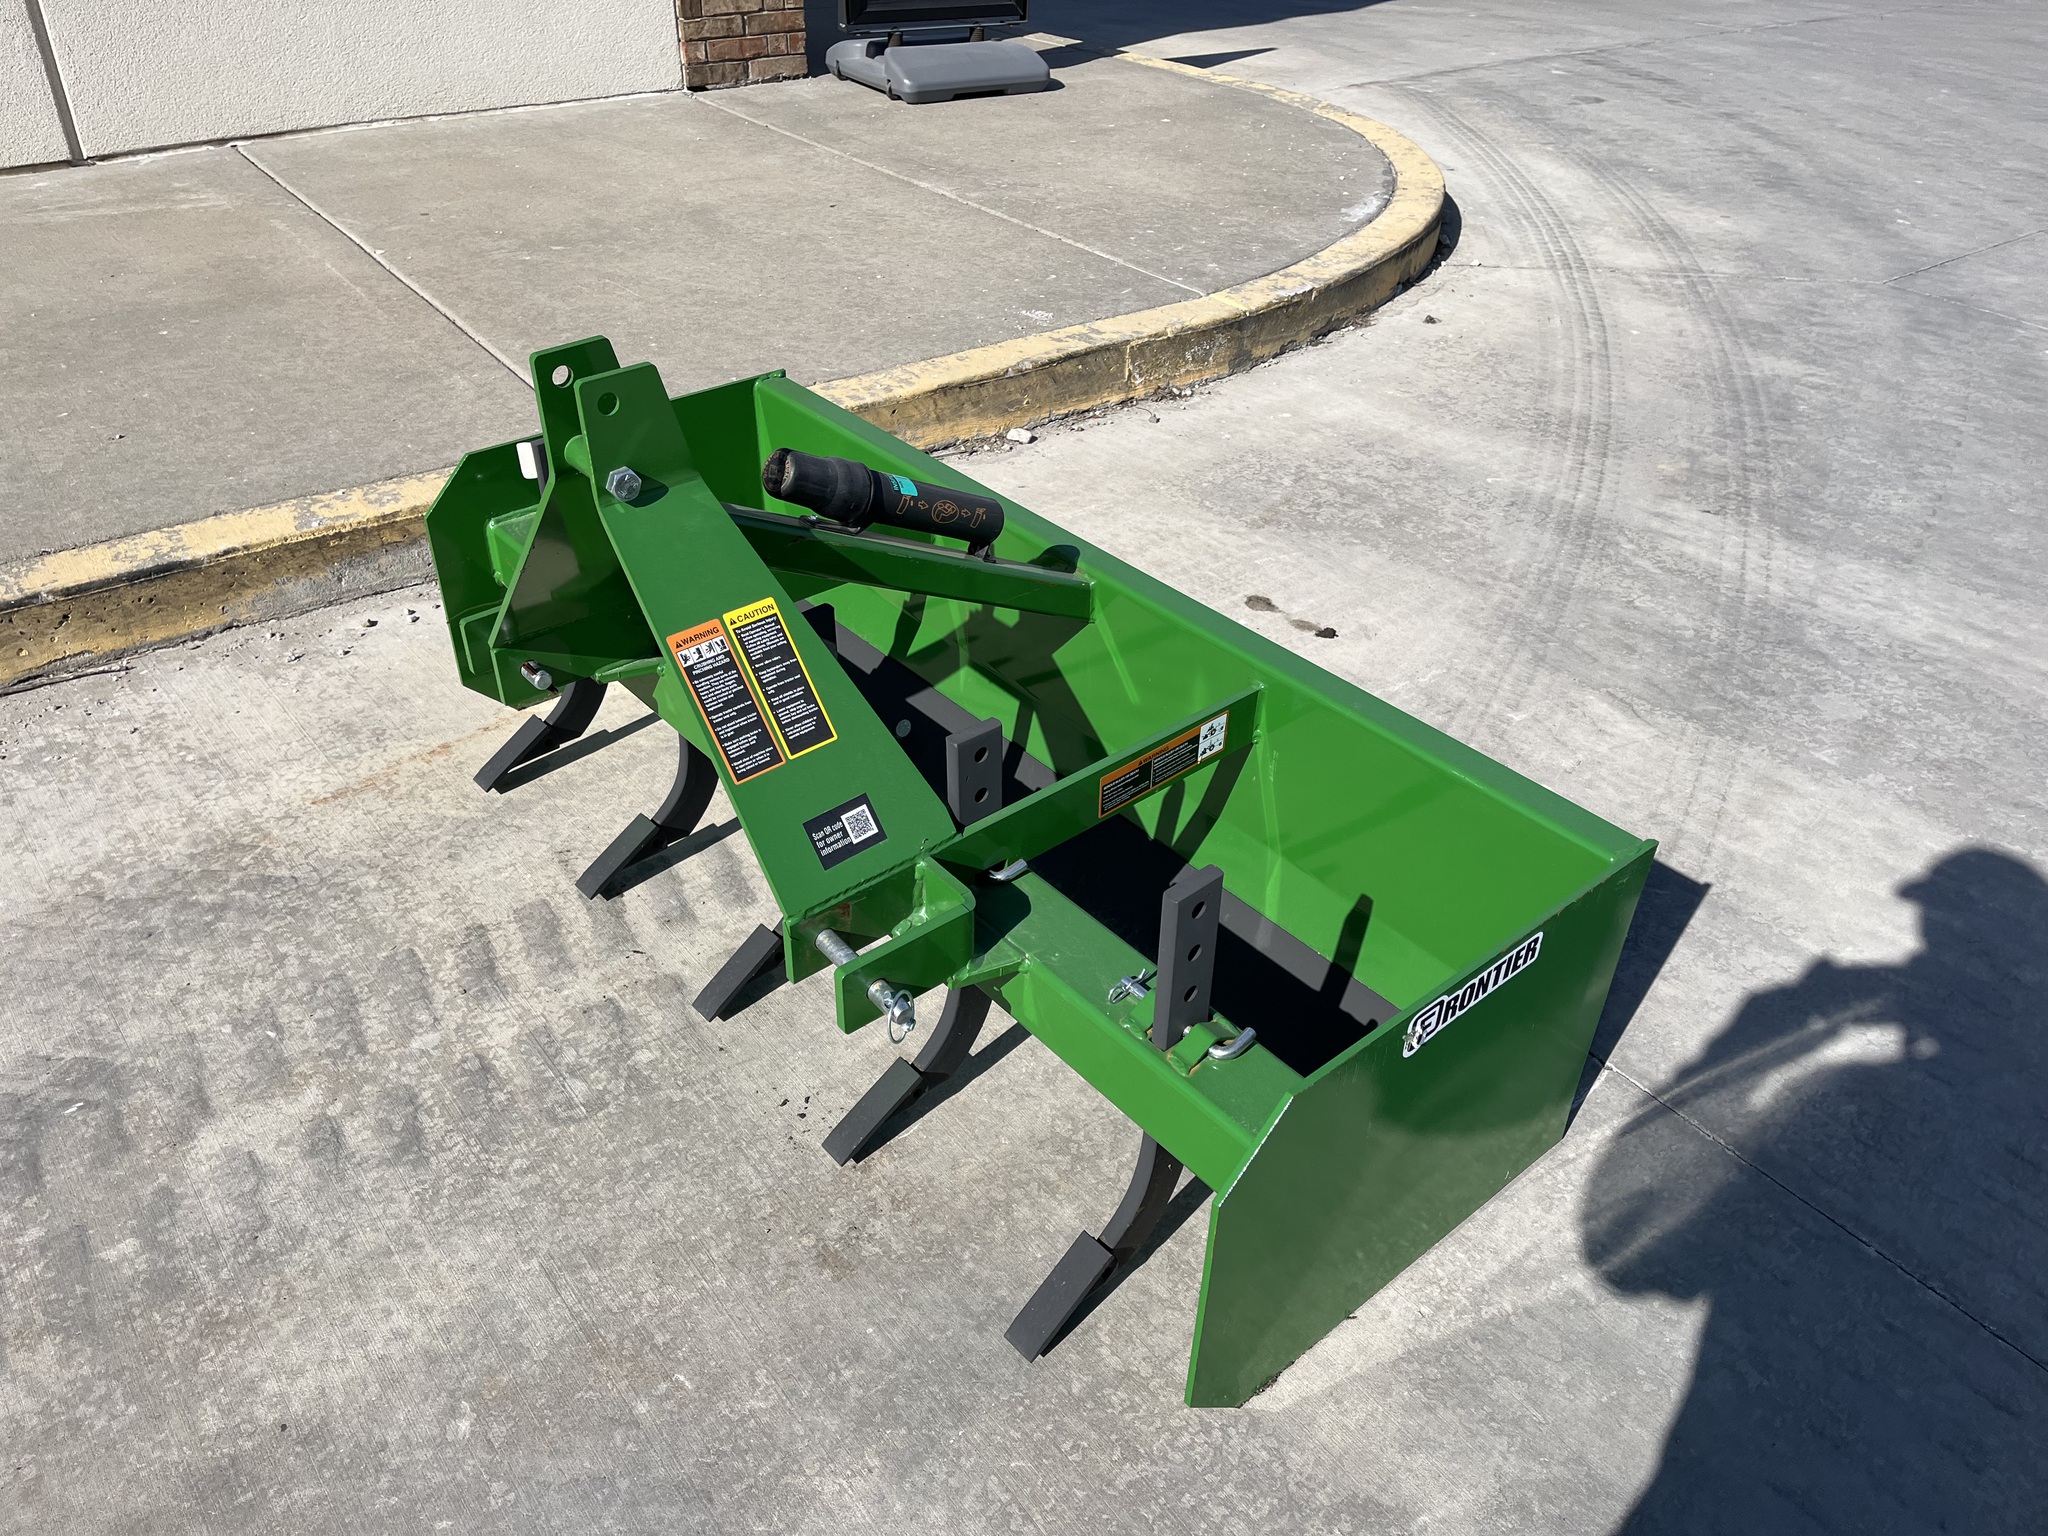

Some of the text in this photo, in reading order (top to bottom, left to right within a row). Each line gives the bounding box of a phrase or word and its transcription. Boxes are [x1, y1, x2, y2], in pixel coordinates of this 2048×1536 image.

[737, 604, 775, 622] CAUTION
[681, 627, 720, 645] WARNING
[820, 837, 851, 856] information
[826, 831, 843, 844] owner
